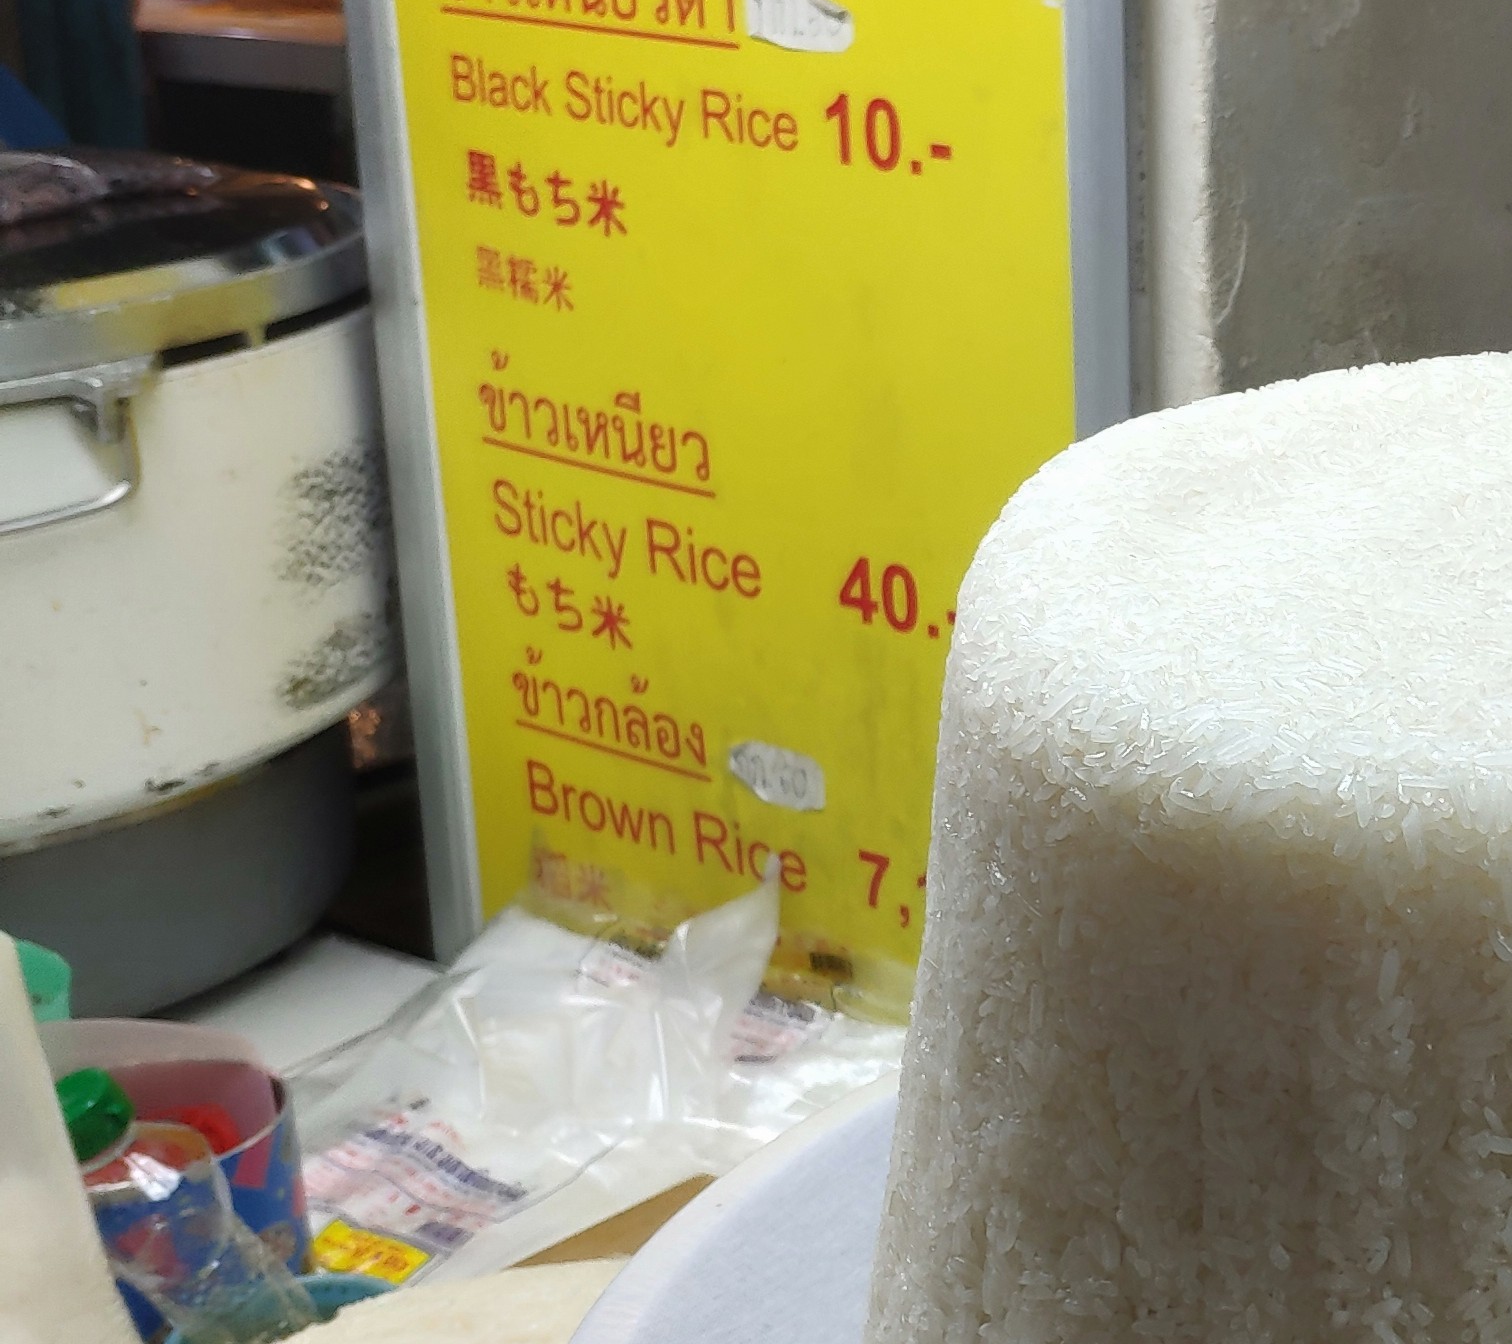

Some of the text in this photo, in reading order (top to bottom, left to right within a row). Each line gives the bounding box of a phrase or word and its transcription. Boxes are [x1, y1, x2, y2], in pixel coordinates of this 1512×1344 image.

[450, 53, 952, 176] Black Sticky Rice 10.-
[478, 350, 711, 483] ข้าวเหนียว
[492, 478, 627, 580] Sticky
[645, 517, 763, 598] Rice
[508, 563, 633, 651] もち米
[512, 646, 708, 769] ข้าวกล้อง
[526, 758, 928, 927] Brown Rice 7,
